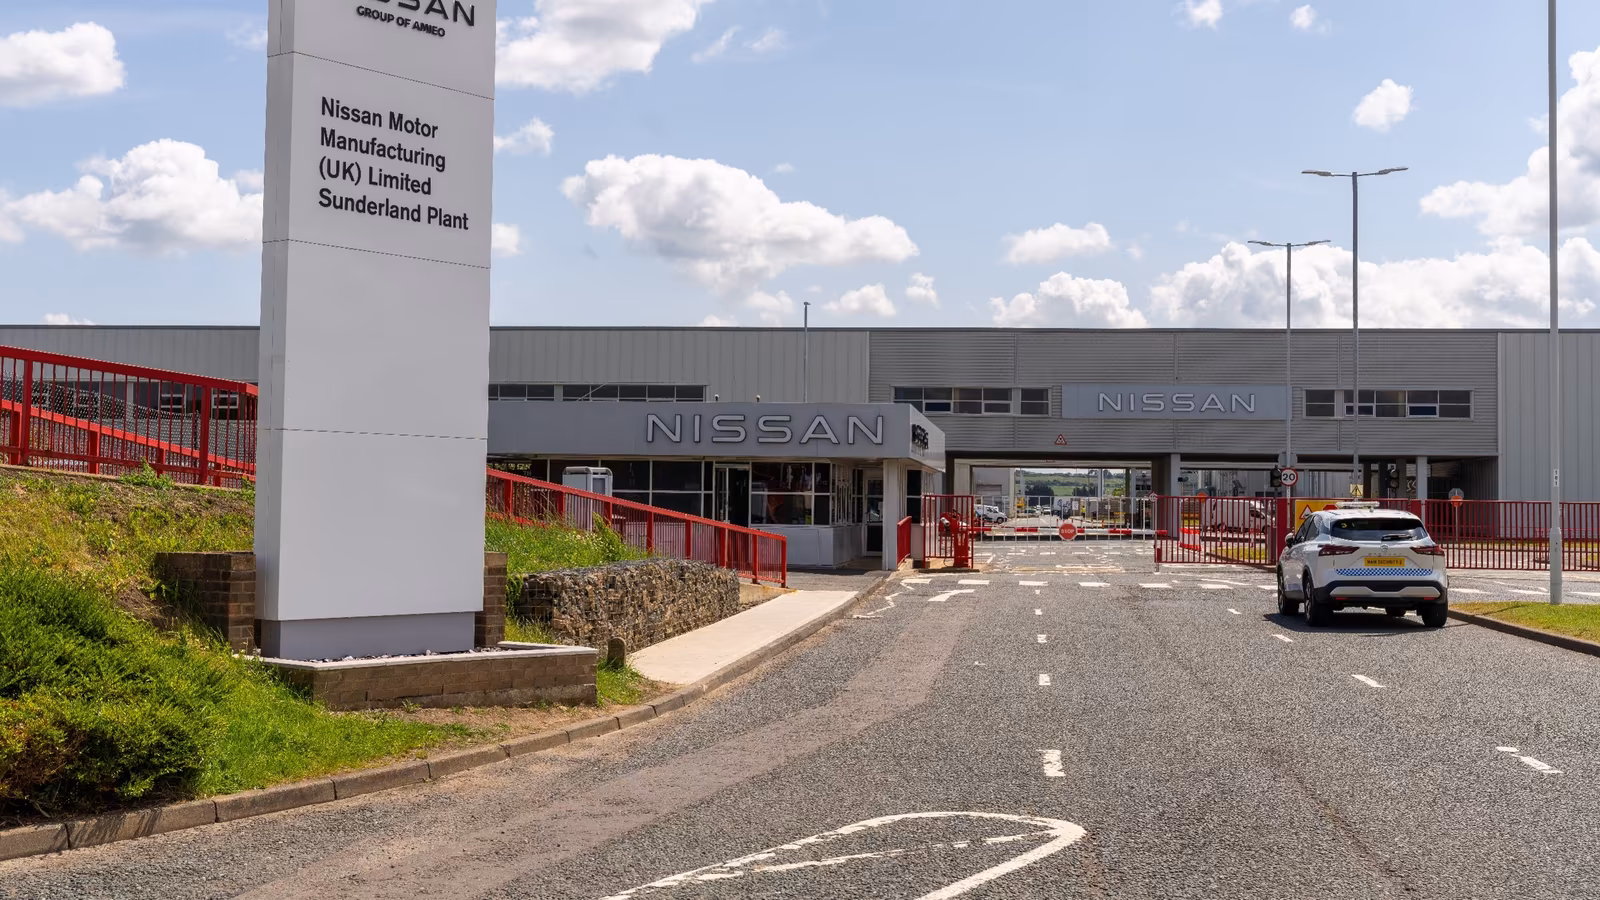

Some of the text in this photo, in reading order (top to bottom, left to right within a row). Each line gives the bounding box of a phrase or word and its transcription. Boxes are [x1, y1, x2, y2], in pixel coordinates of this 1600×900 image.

[356, 5, 446, 37] GROUP OF AMIEO
[321, 96, 438, 138] Nissan Motor
[320, 126, 446, 173] Manufacturing
[319, 155, 431, 196] (UK) Limited
[318, 187, 469, 231] Sunderland Plant
[1098, 393, 1255, 413] NISSAN
[646, 413, 884, 445] NISSAN
[1282, 473, 1296, 482] 20
